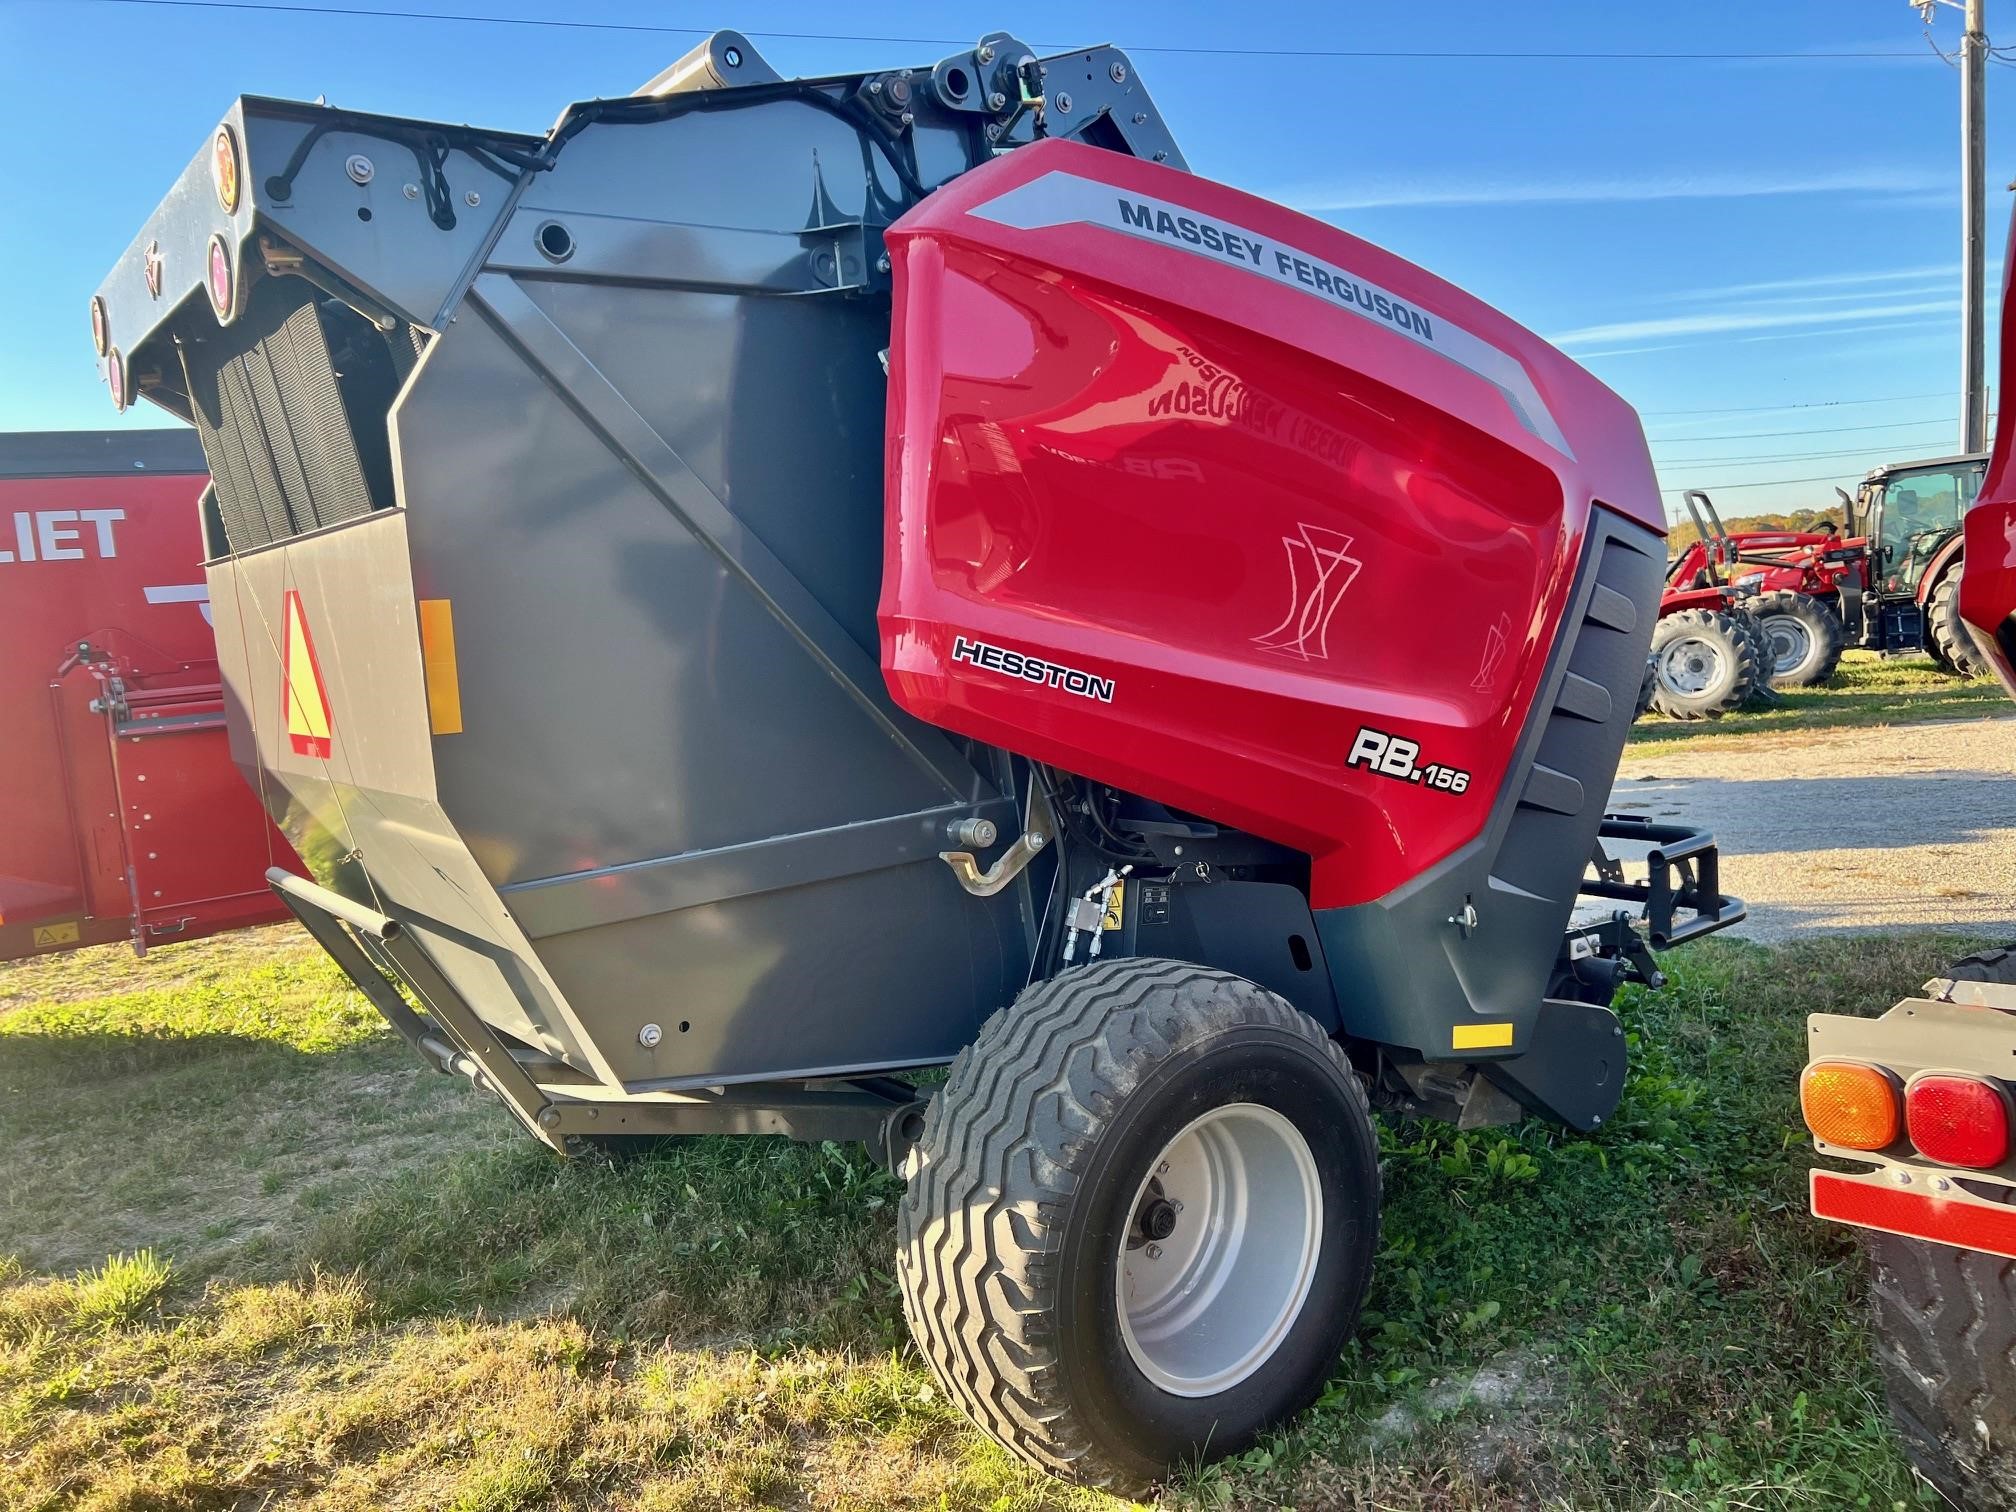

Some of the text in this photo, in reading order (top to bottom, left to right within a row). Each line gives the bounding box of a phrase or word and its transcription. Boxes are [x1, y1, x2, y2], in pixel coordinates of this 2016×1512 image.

[1117, 198, 1434, 341] MASSEY FERGUSON
[953, 636, 1115, 703] HESSTON
